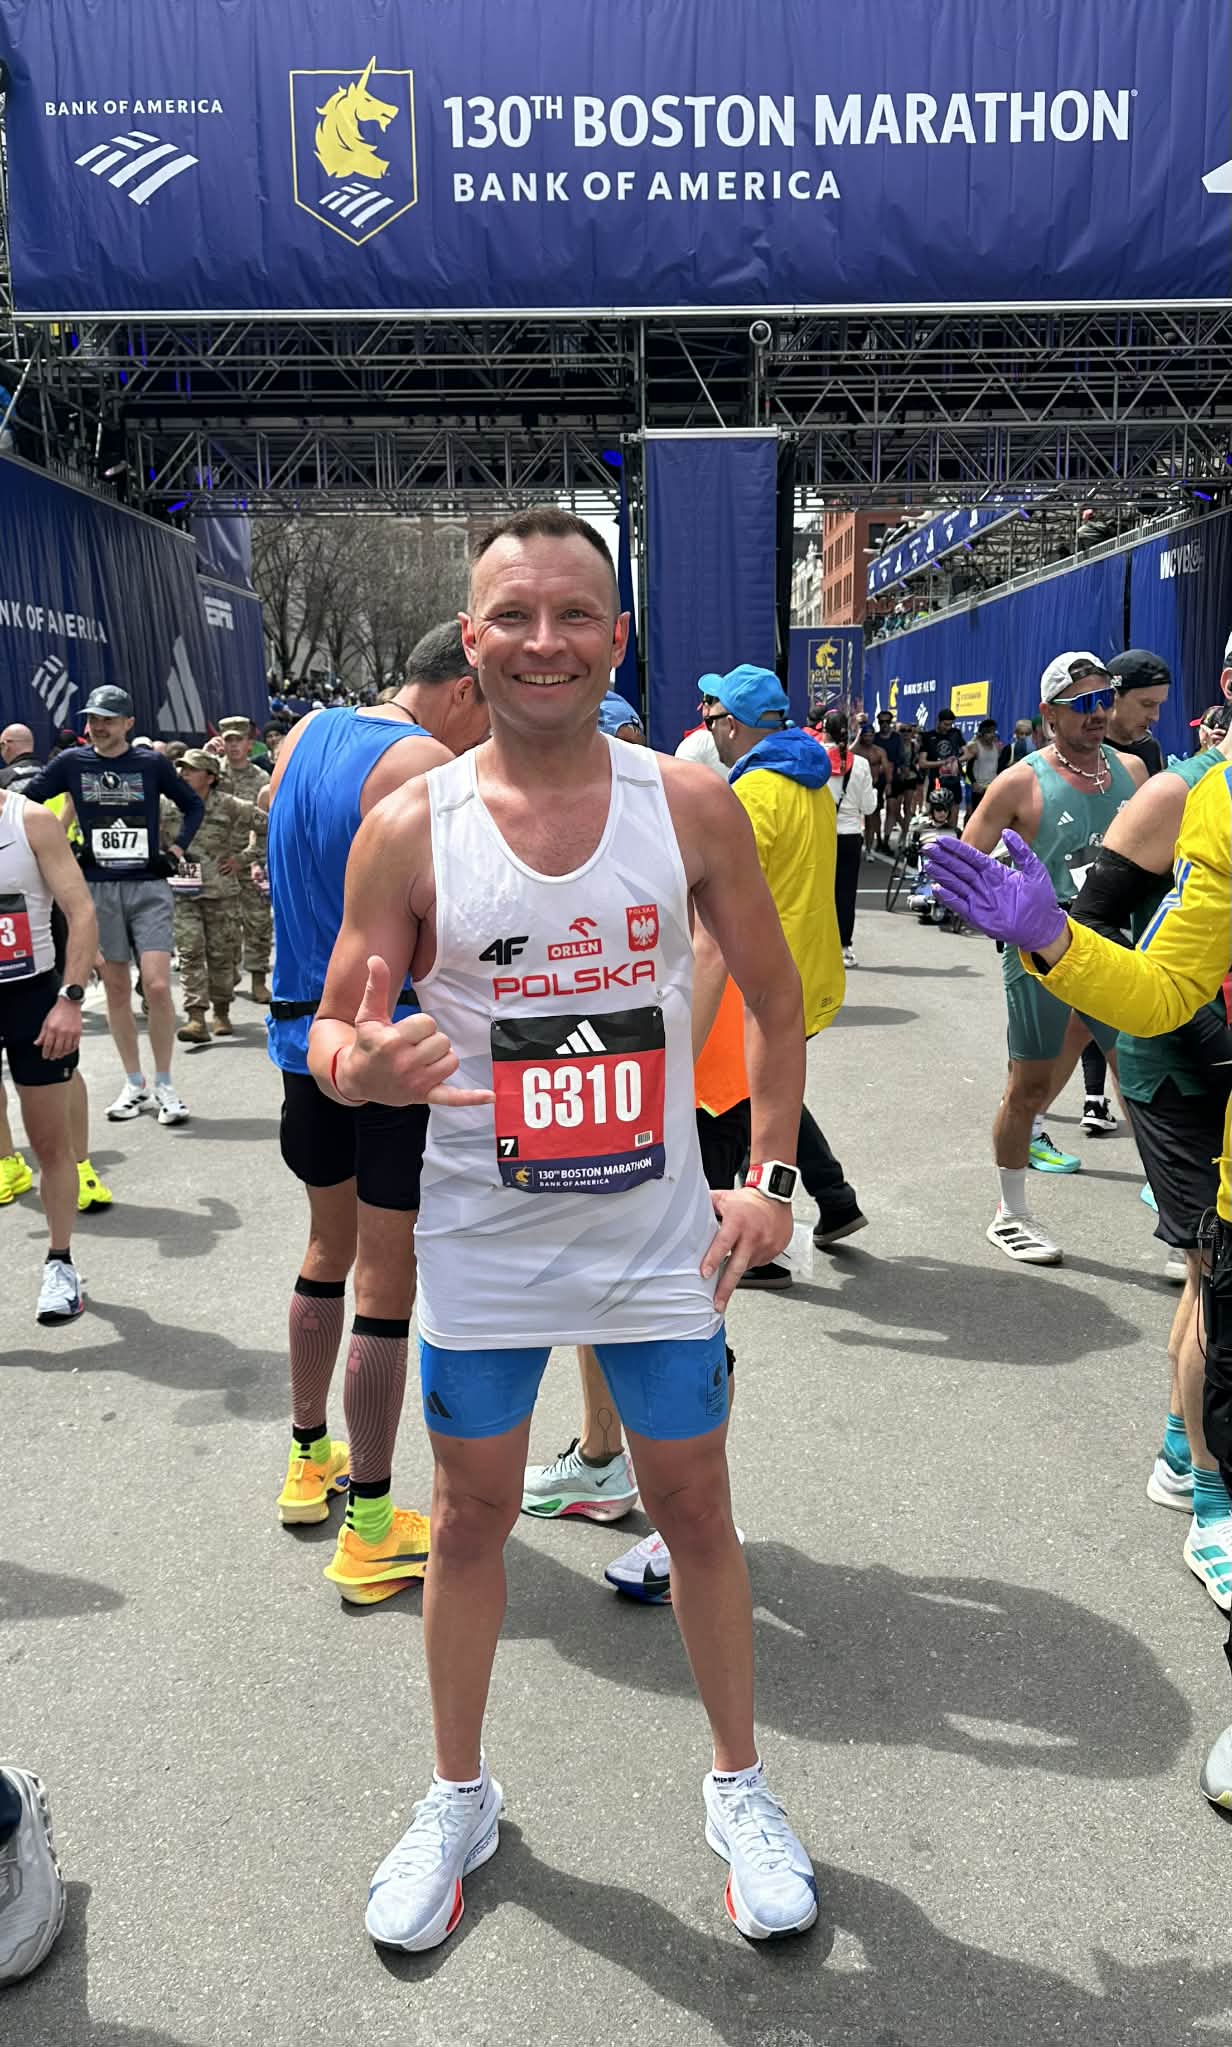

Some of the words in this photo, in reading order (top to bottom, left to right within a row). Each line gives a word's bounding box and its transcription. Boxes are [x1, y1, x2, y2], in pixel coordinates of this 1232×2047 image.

[45, 101, 98, 116] BANK
[104, 100, 128, 114] OF
[133, 99, 223, 114] AMERICA
[574, 95, 795, 148] BOSTON
[815, 90, 1130, 146] MARATHON
[453, 172, 569, 202] BANK
[582, 171, 635, 201] OF
[647, 170, 841, 201] AMERICA
[26, 604, 44, 632] OF
[101, 831, 138, 849] 8677
[478, 936, 529, 966] 4F
[551, 941, 599, 958] ORLEN
[492, 959, 656, 1001] POLSKA
[522, 1060, 642, 1129] 6310
[500, 1139, 515, 1156] 7
[561, 1168, 601, 1178] BOSTON
[603, 1157, 652, 1176] MARATHON
[574, 1178, 610, 1186] AMERICA
